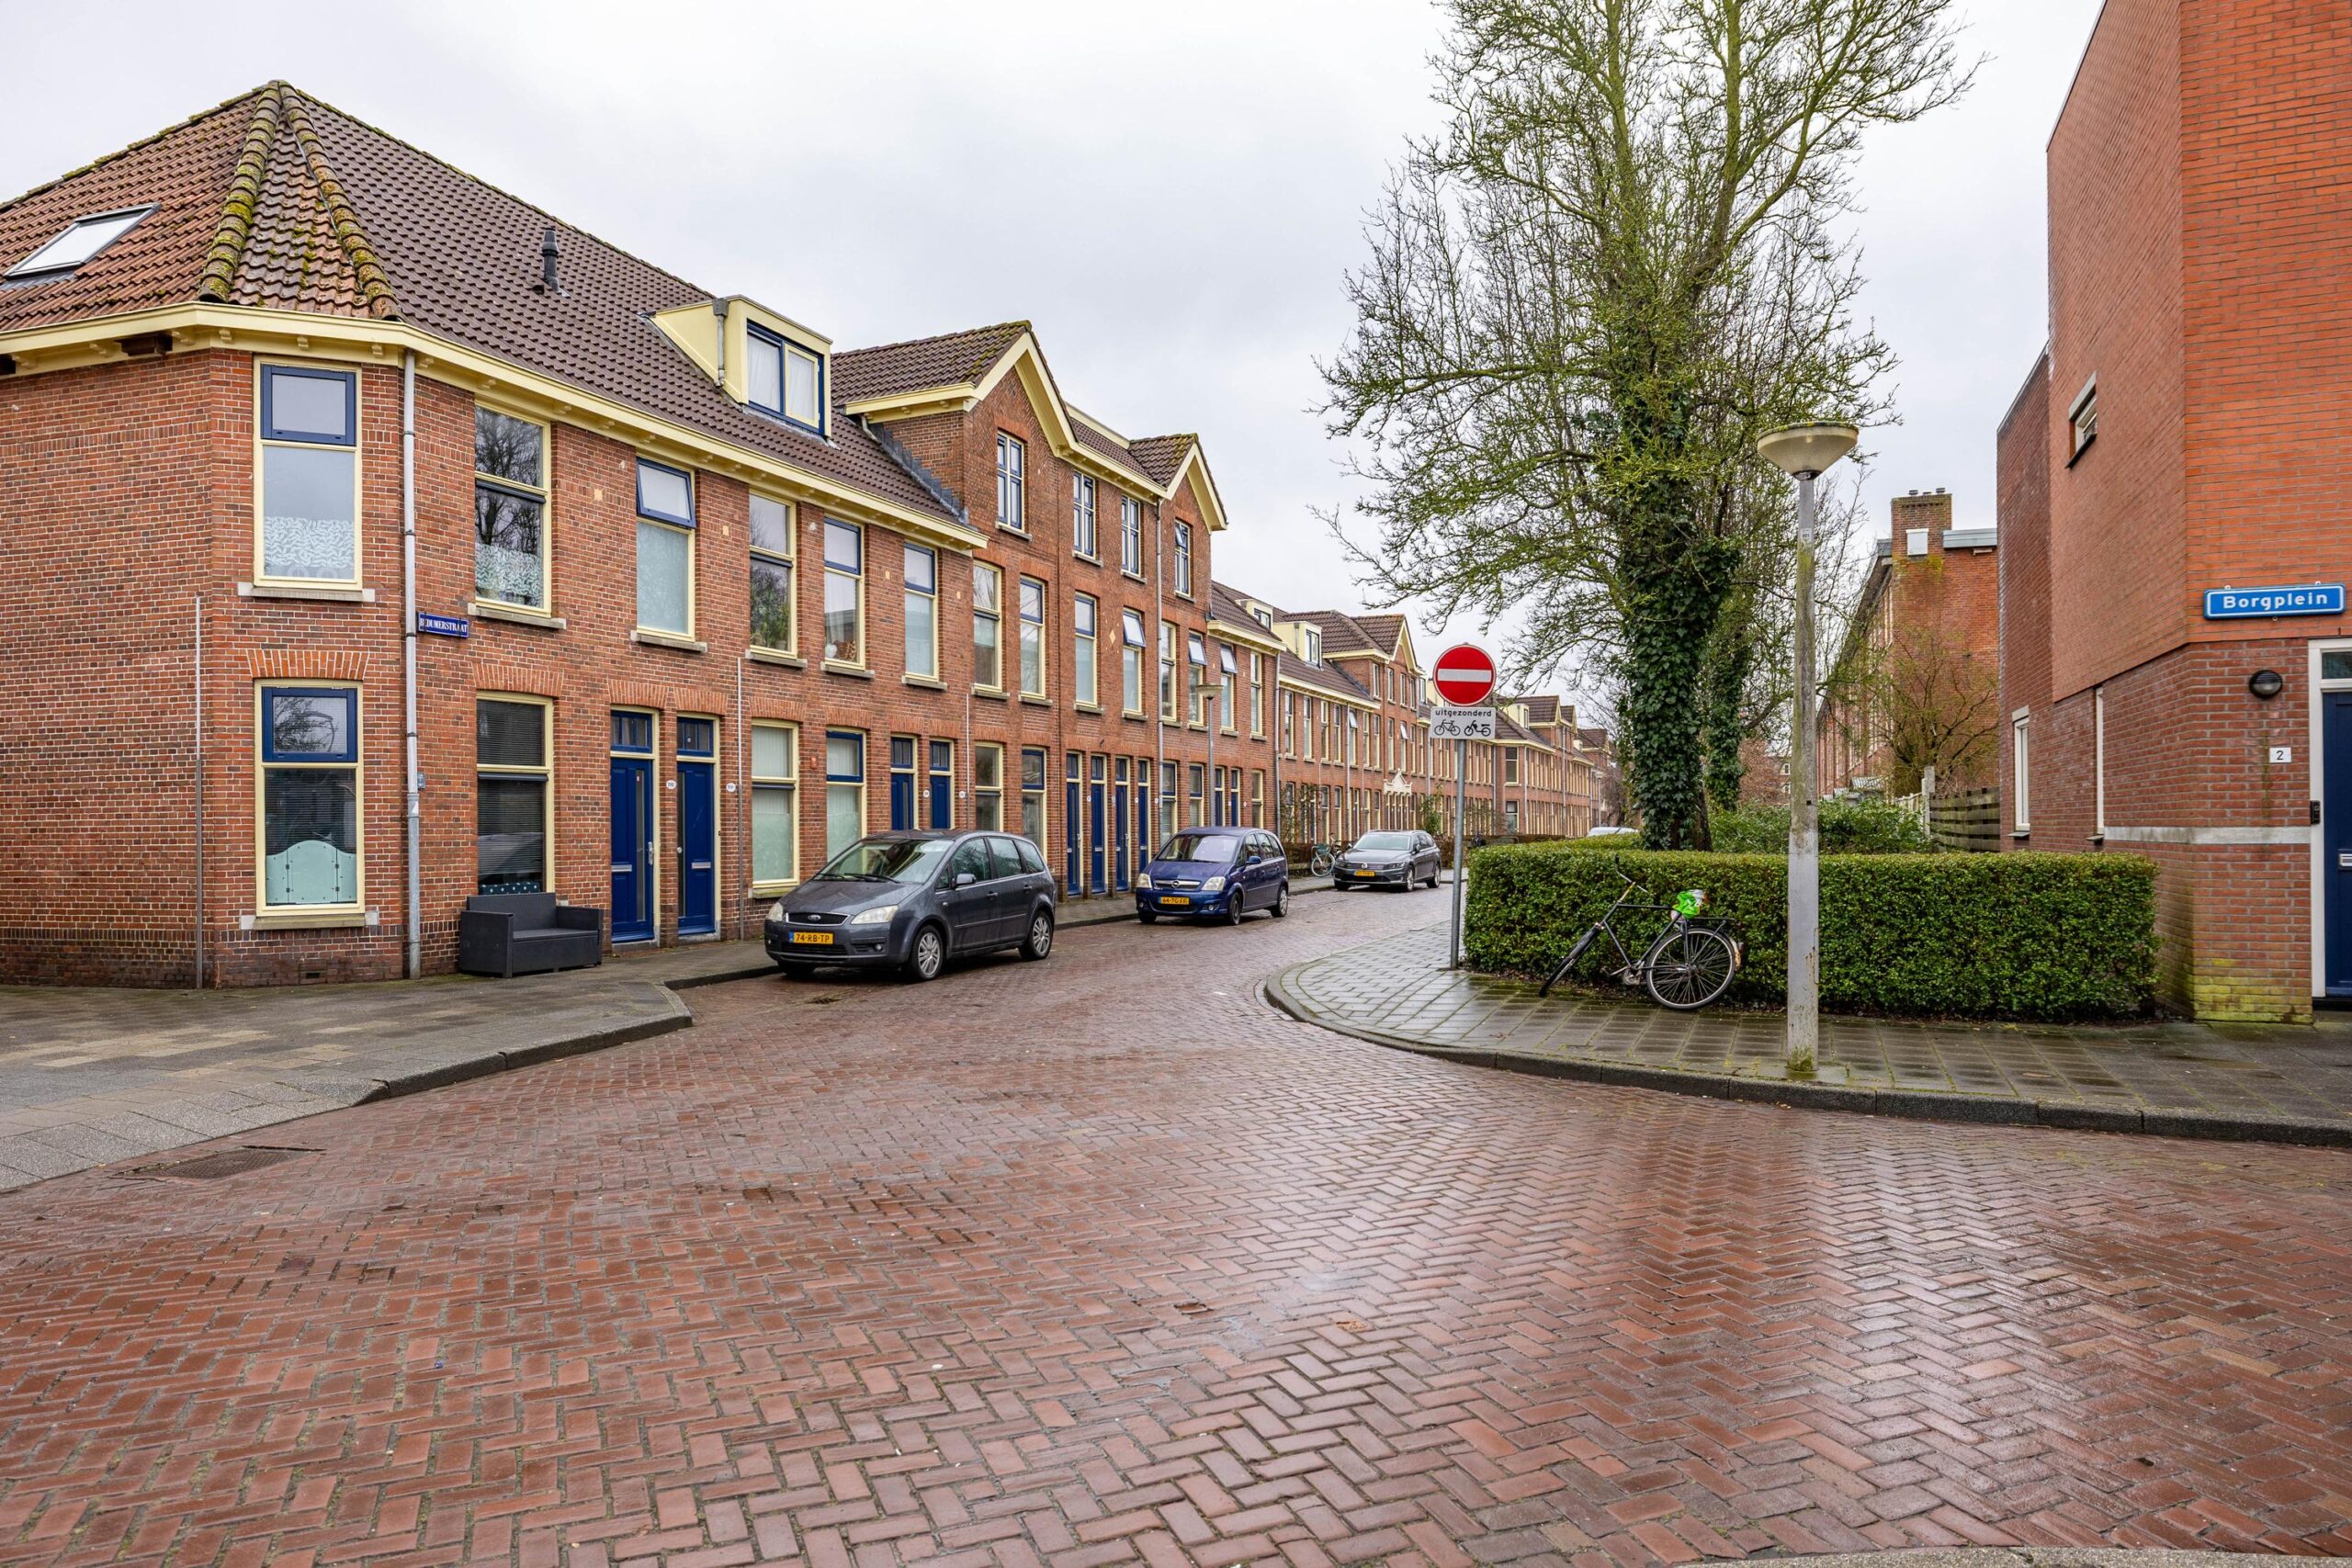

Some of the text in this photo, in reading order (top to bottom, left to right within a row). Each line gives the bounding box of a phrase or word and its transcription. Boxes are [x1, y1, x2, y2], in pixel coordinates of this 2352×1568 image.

[2222, 592, 2328, 611] Borgplein
[1435, 708, 1492, 717] uitgezonderd
[2276, 750, 2284, 761] 2
[796, 933, 830, 942] 74-RB-TP
